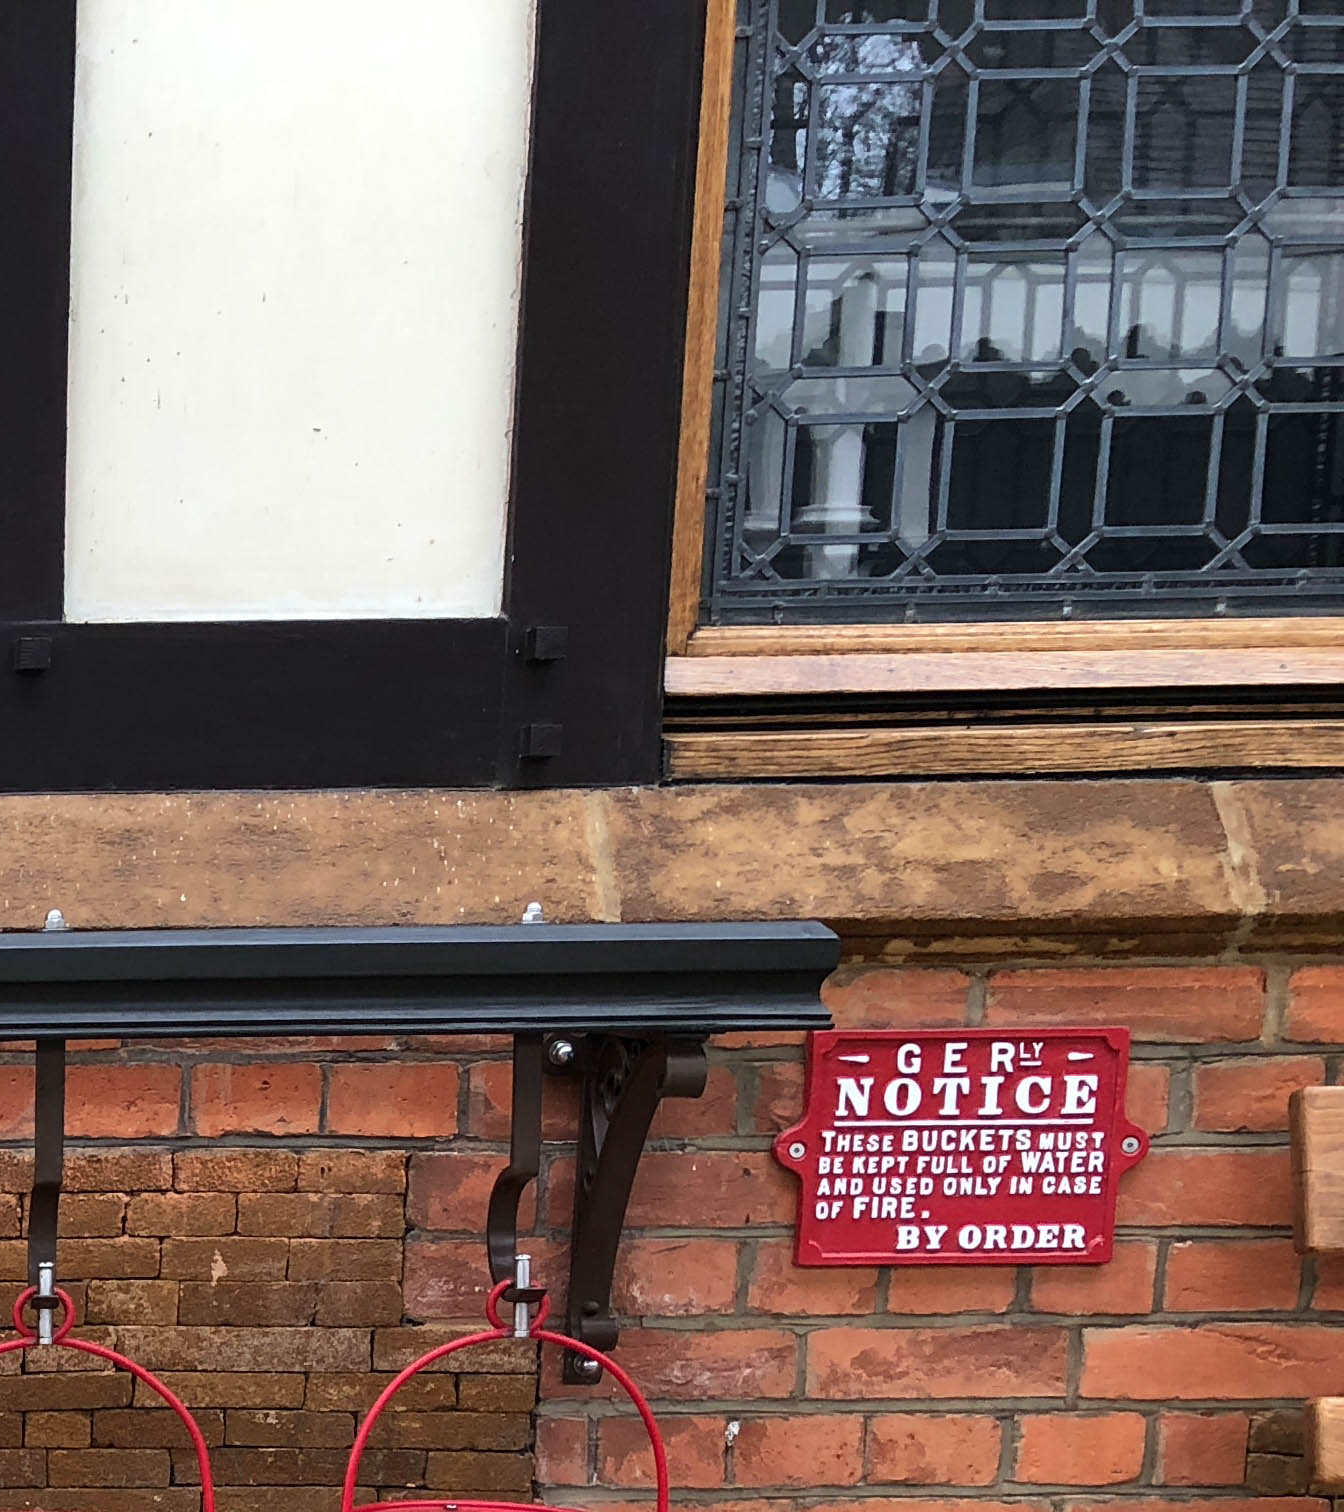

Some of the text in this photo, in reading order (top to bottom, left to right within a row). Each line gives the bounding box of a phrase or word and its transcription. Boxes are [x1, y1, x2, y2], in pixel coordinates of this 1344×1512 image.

[898, 1044, 921, 1073] G
[944, 1043, 967, 1073] E
[835, 1075, 1098, 1116] NOTICE
[822, 1129, 1104, 1152] THESE BUCKETS MUST
[819, 1151, 1104, 1174] BE KEPT FULL OF WATER
[817, 1176, 1101, 1195] AND USED ONLY IN CASE
[816, 1197, 929, 1219] OF FIRE.
[896, 1224, 1085, 1249] BY ORDER
